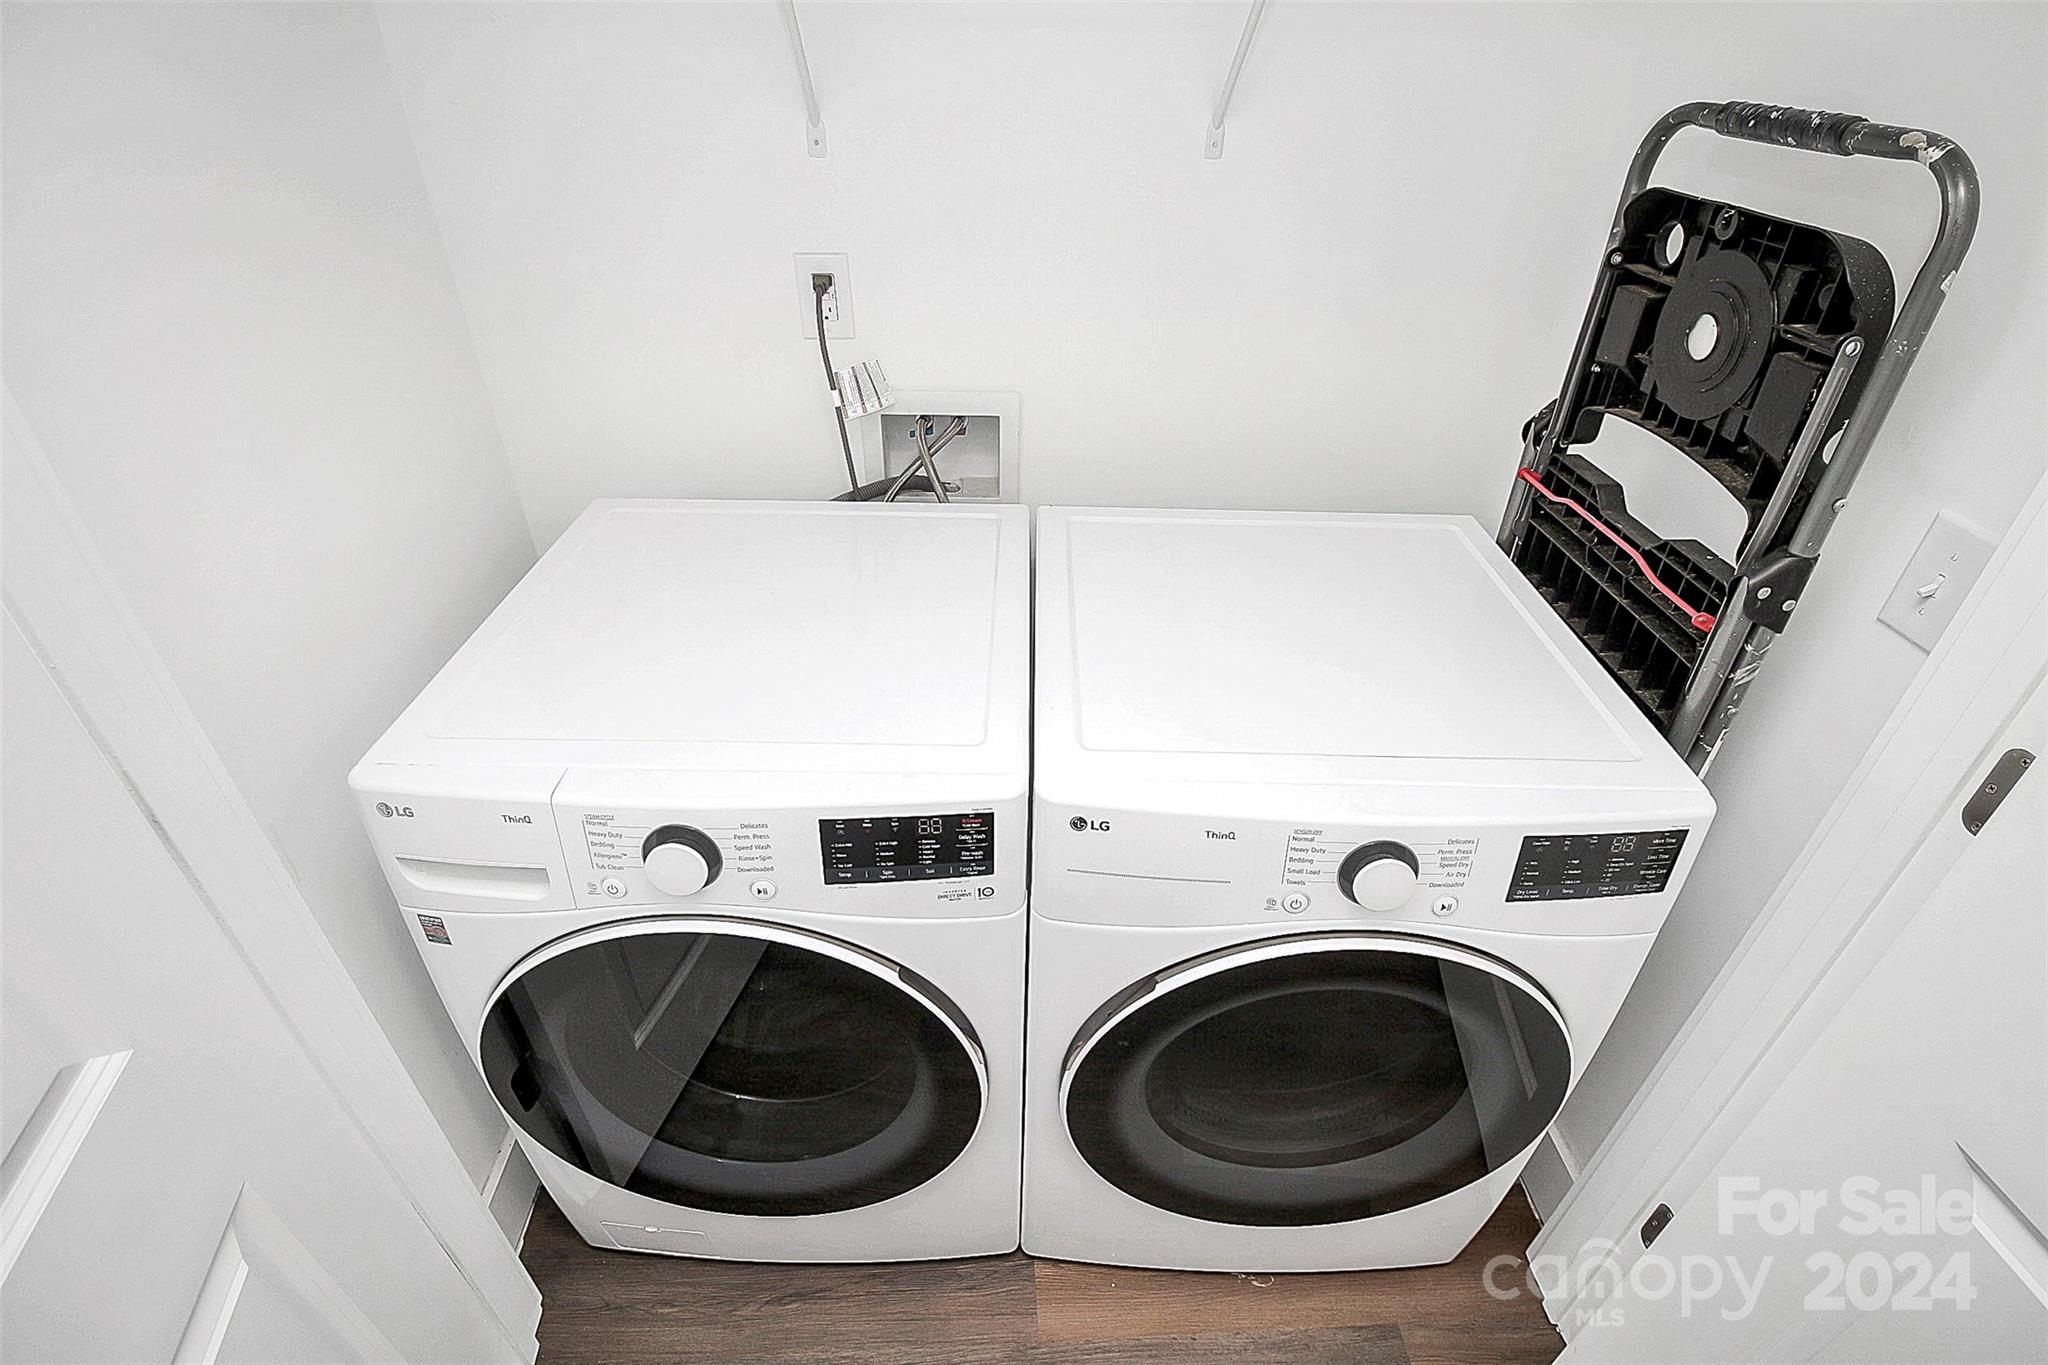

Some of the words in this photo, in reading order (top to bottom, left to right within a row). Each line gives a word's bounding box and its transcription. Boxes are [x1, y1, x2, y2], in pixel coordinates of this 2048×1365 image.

[395, 806, 415, 818] LG
[501, 814, 533, 825] ThinQ
[1090, 820, 1110, 831] LG
[588, 831, 607, 839] Heavy
[1205, 830, 1236, 840] ThinQ
[590, 841, 615, 849] Bedding
[1286, 878, 1306, 886] Towels
